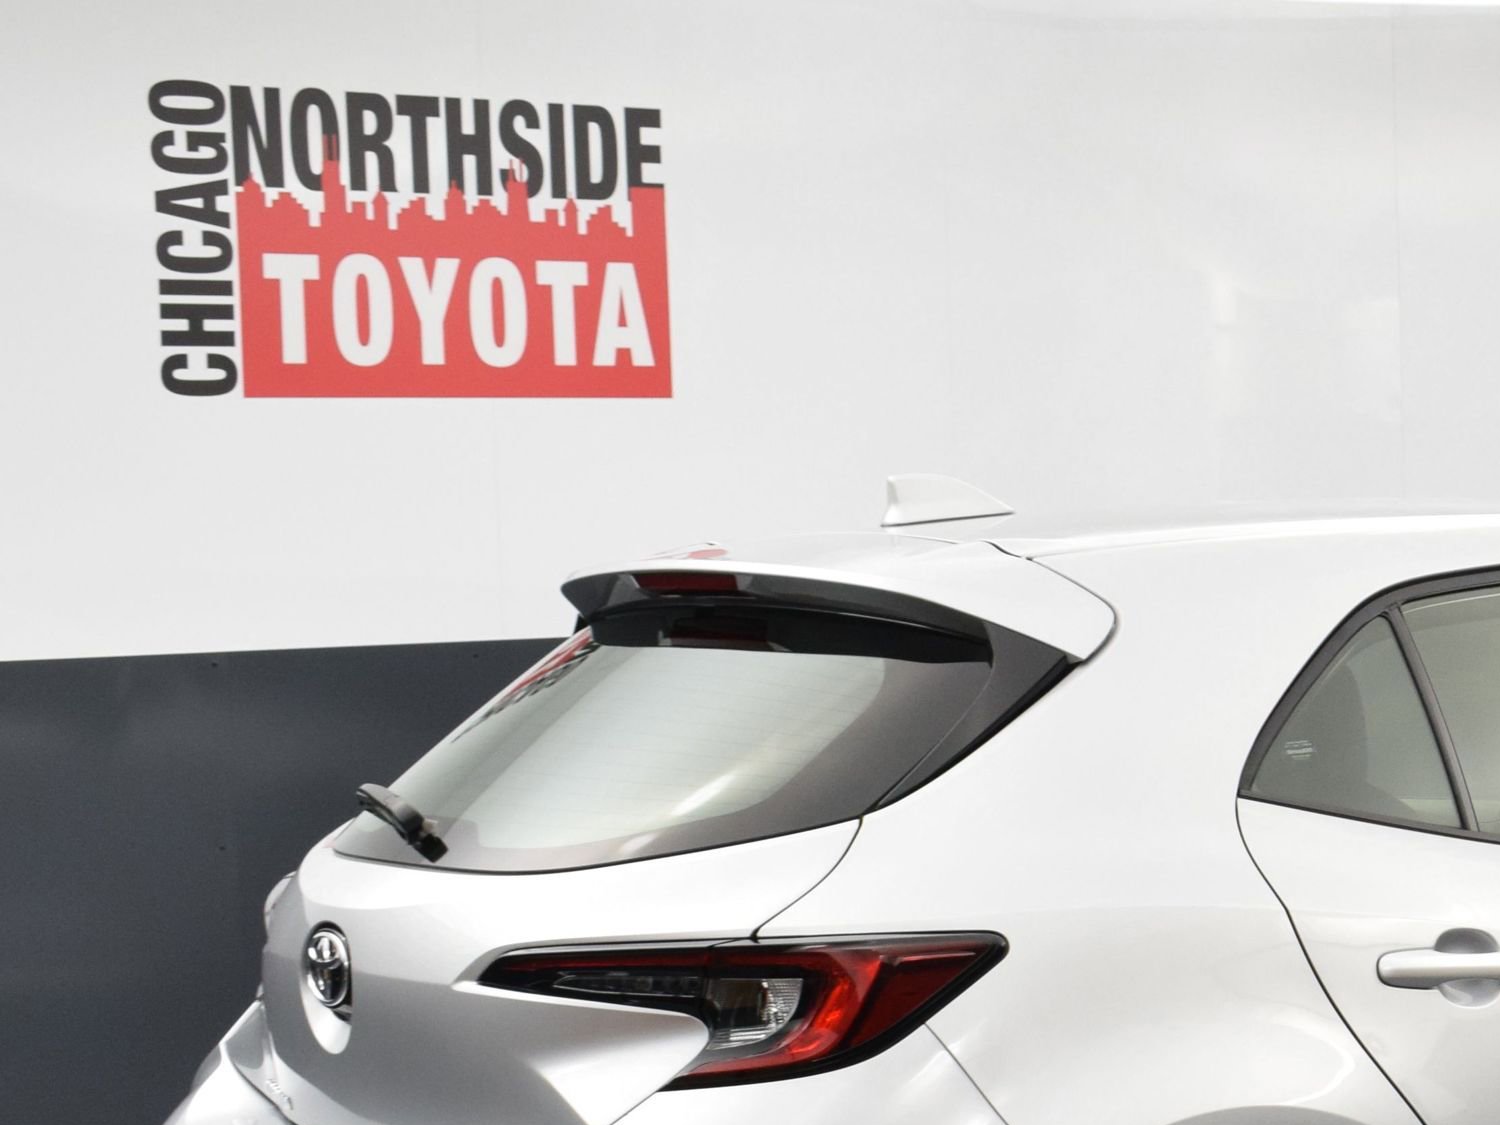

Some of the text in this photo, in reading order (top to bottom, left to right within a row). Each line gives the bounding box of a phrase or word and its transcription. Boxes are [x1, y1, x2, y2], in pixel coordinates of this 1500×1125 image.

[229, 84, 663, 200] NORTHSIDE
[148, 79, 237, 396] CHICAGO
[262, 252, 655, 368] TOYOTA
